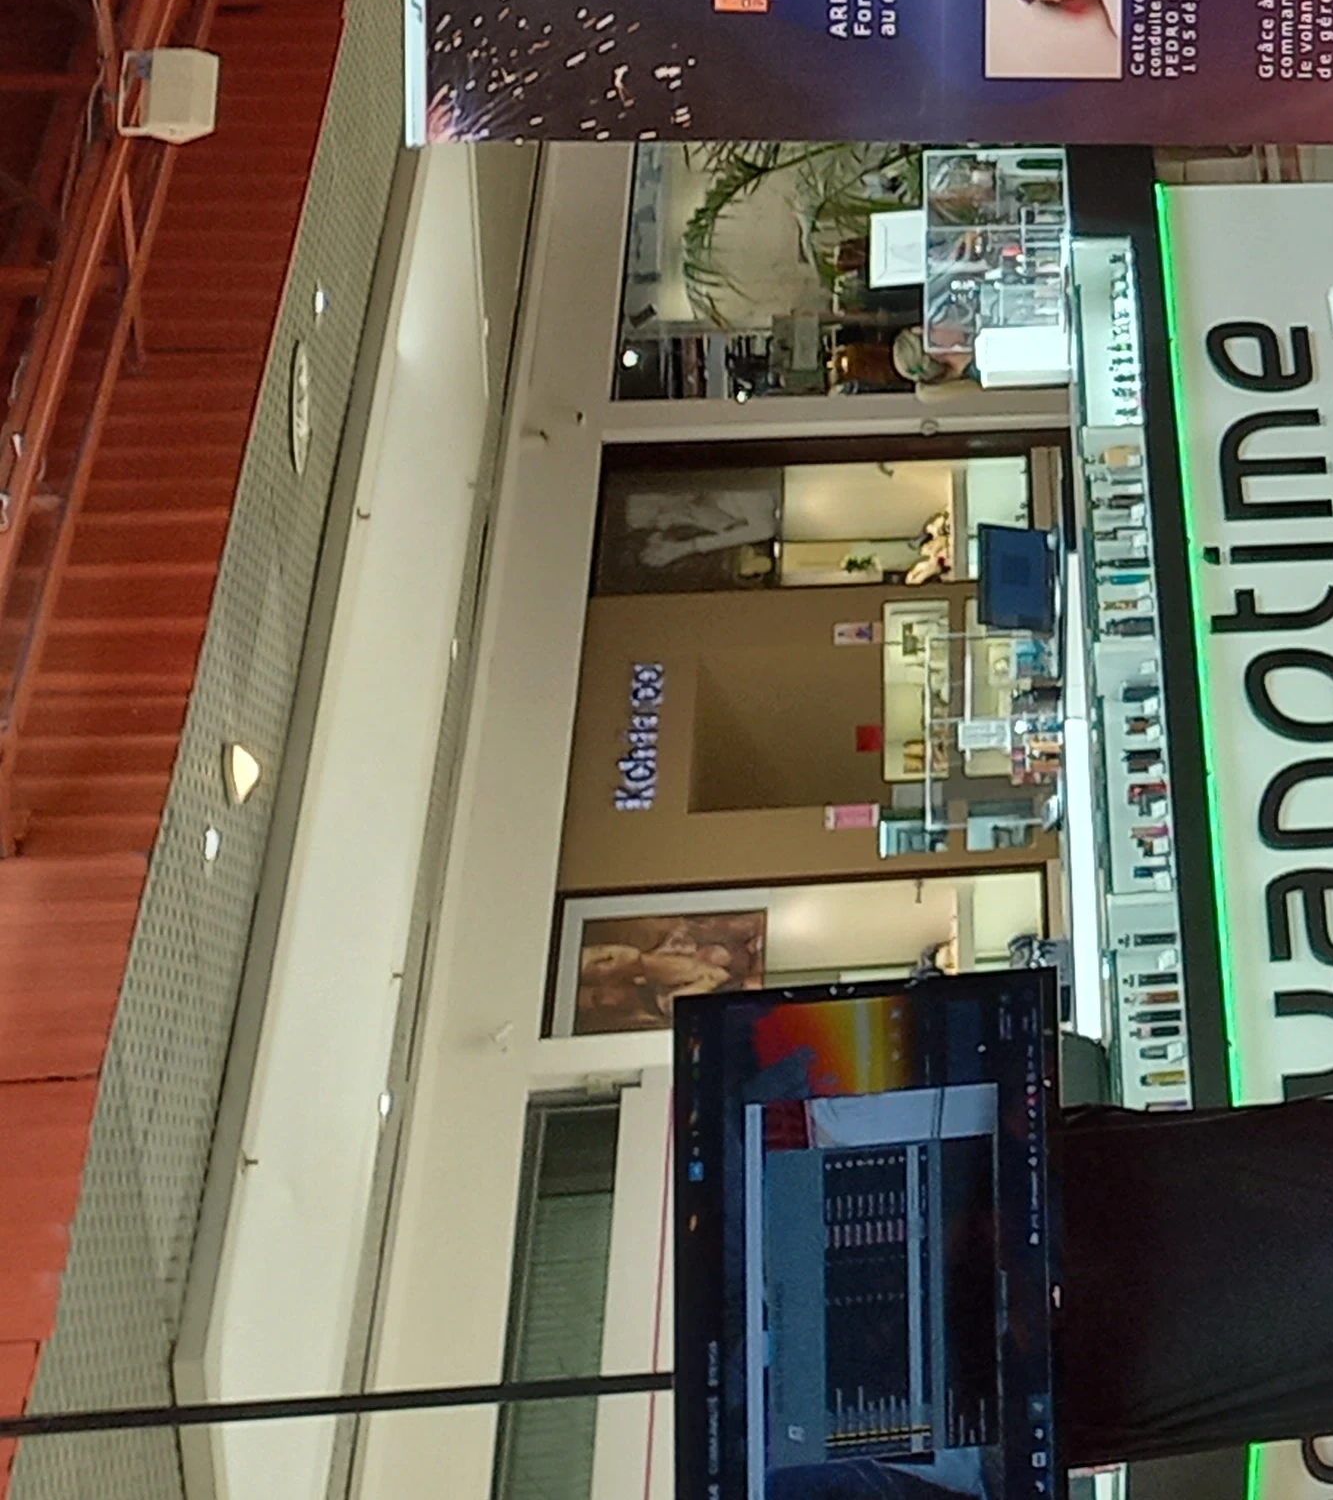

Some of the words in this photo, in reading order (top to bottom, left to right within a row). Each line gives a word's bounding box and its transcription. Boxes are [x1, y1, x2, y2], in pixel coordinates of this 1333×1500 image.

[880, 10, 896, 36] au
[1131, 23, 1145, 75] Cette
[1148, 1, 1162, 77] conduite
[1166, 11, 1179, 77] PEDRO
[1257, 19, 1274, 78] Grâce
[1297, 61, 1312, 78] le
[1317, 54, 1332, 78] de
